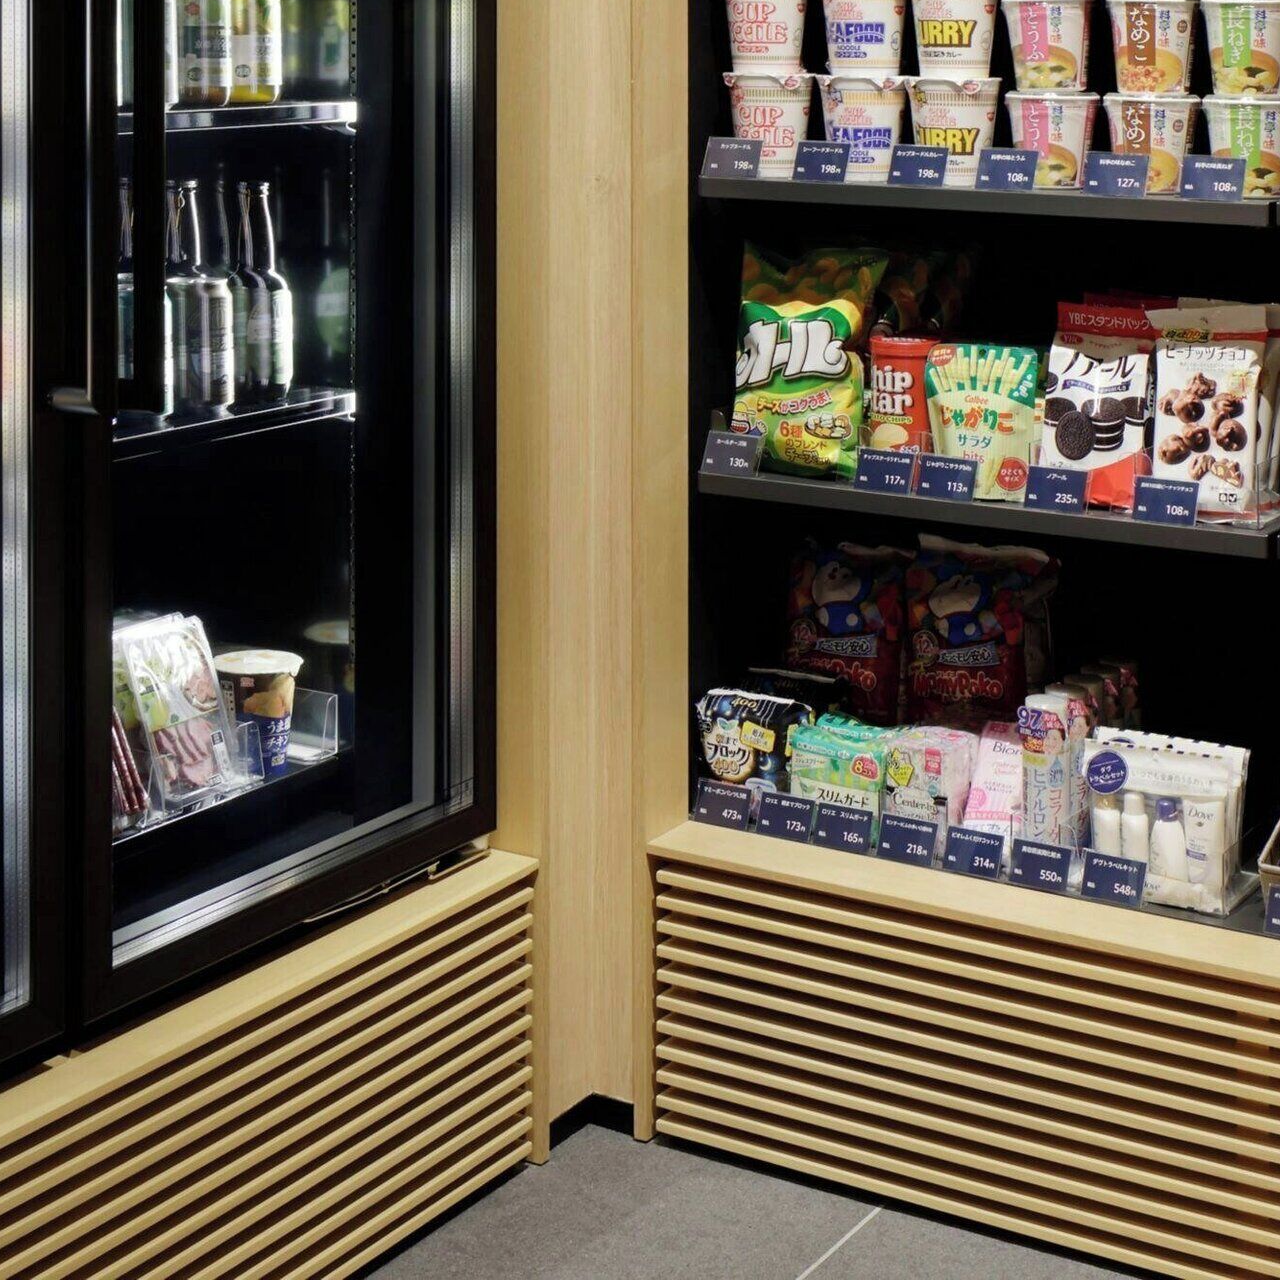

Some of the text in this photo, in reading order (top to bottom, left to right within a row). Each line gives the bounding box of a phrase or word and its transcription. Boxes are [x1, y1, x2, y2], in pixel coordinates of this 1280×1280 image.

[731, 0, 777, 22] CUP
[919, 19, 978, 48] URRY
[1026, 7, 1046, 62] とうふ
[1129, 6, 1152, 62] なめこ
[1225, 9, 1246, 64] 長ねぎ
[837, 44, 862, 52] NOODLE
[738, 105, 784, 127] CUP
[802, 146, 844, 155] シーフードヌードル
[895, 150, 944, 159] カップヌードルカレー
[733, 160, 754, 170] 198円
[820, 164, 842, 175] 198円
[917, 168, 940, 179] 198円
[1007, 172, 1029, 183] 108円
[1117, 177, 1141, 189] 127円
[1212, 181, 1237, 192] 108円
[1164, 343, 1248, 363] ピーナッツチョコ
[940, 404, 1014, 434] じゃがりこ
[956, 433, 994, 449] サラダ
[729, 457, 749, 468] 130円
[884, 474, 906, 486] 117円
[1046, 472, 1069, 482] ノアール
[946, 481, 969, 494] 113円
[1054, 492, 1079, 505] 235円
[1166, 503, 1190, 517] 108円
[817, 786, 870, 810] スリムガード
[1033, 768, 1047, 840] ヒアルロン
[721, 808, 743, 822] 473円
[1187, 805, 1216, 821] Dove
[785, 819, 807, 833] 173円
[843, 831, 864, 846] 165円
[905, 842, 929, 857] 218円
[972, 855, 996, 870] 314円
[1038, 868, 1063, 884] 550円
[1113, 882, 1138, 898] 548円
